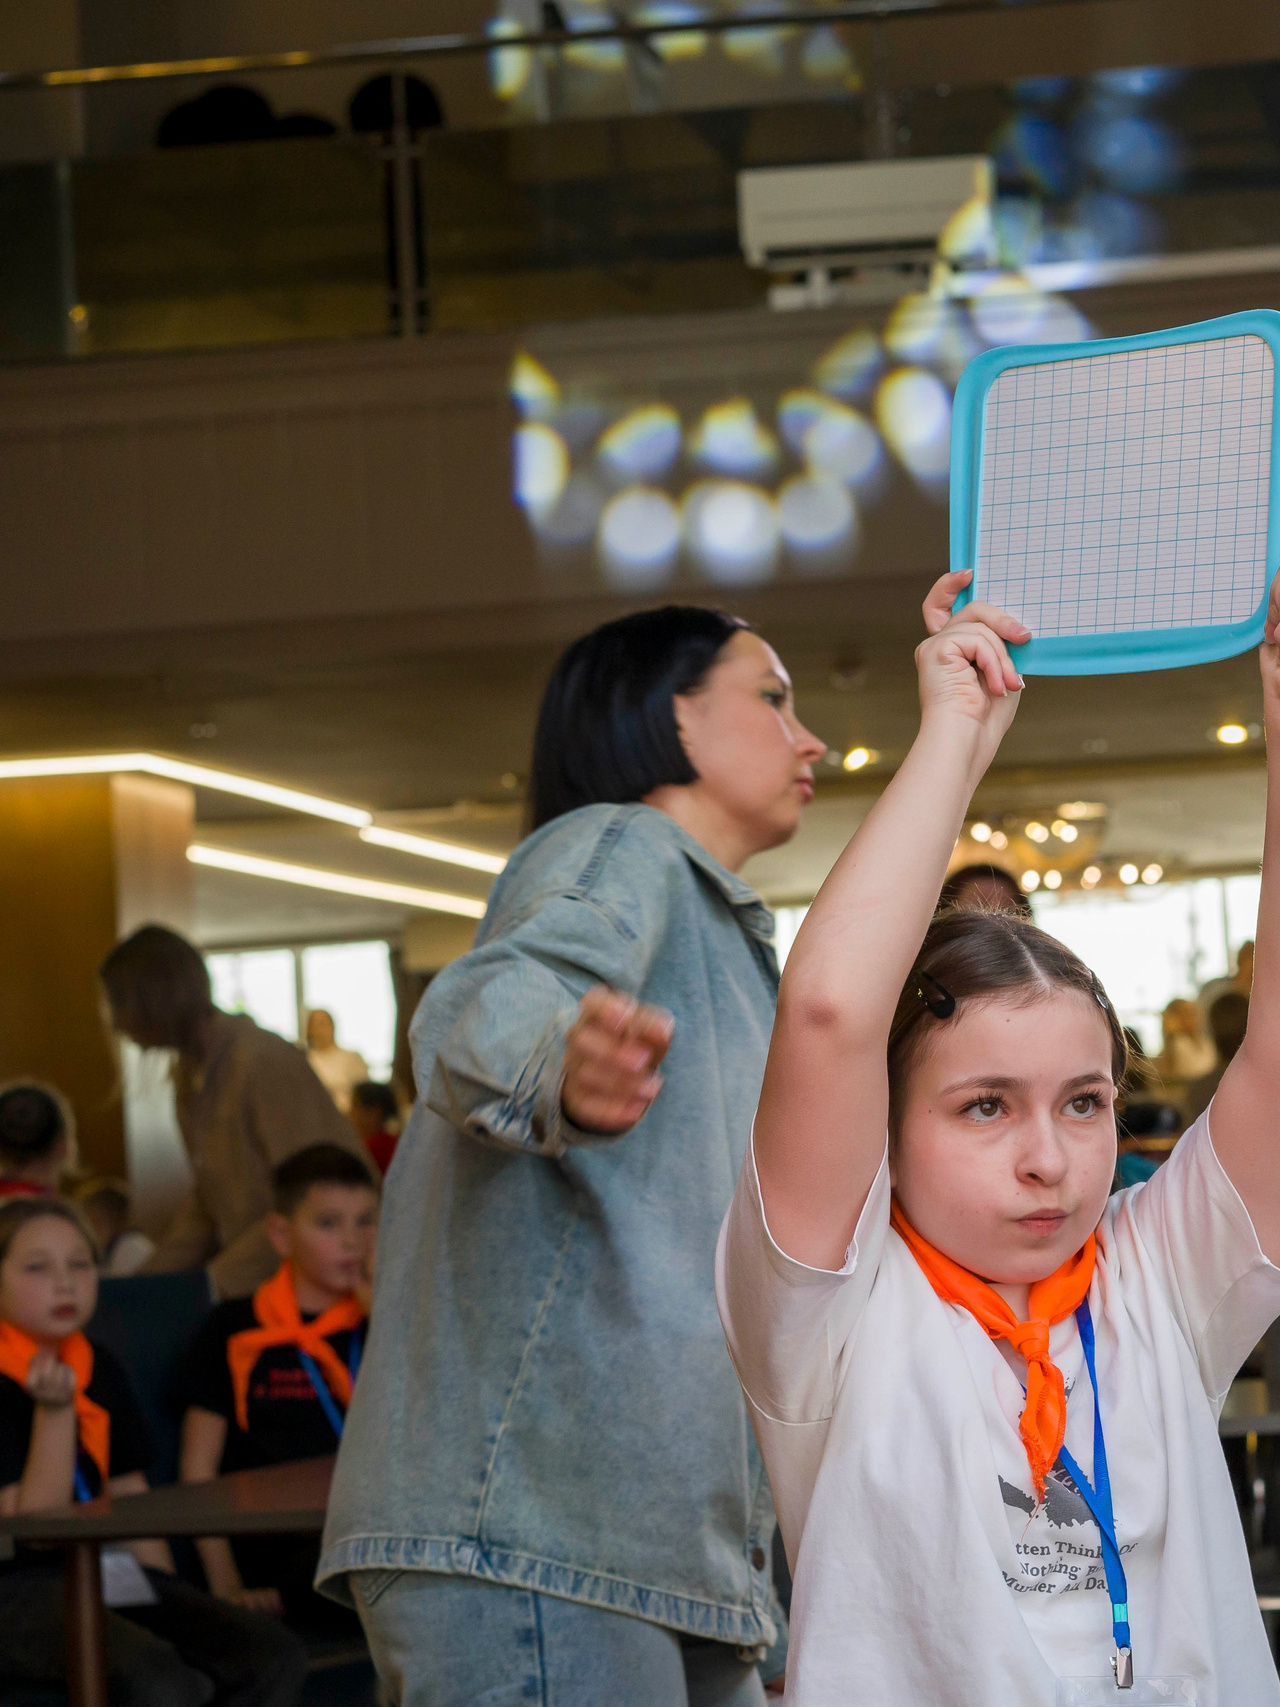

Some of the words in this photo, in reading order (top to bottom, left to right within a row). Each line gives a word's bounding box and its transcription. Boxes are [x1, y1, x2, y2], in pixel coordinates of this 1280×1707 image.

[1055, 1541, 1104, 1558] Think
[1020, 1556, 1081, 1580] Nothing
[1002, 1571, 1056, 1594] Murder
[1059, 1581, 1082, 1594] All
[1085, 1577, 1109, 1592] Da
